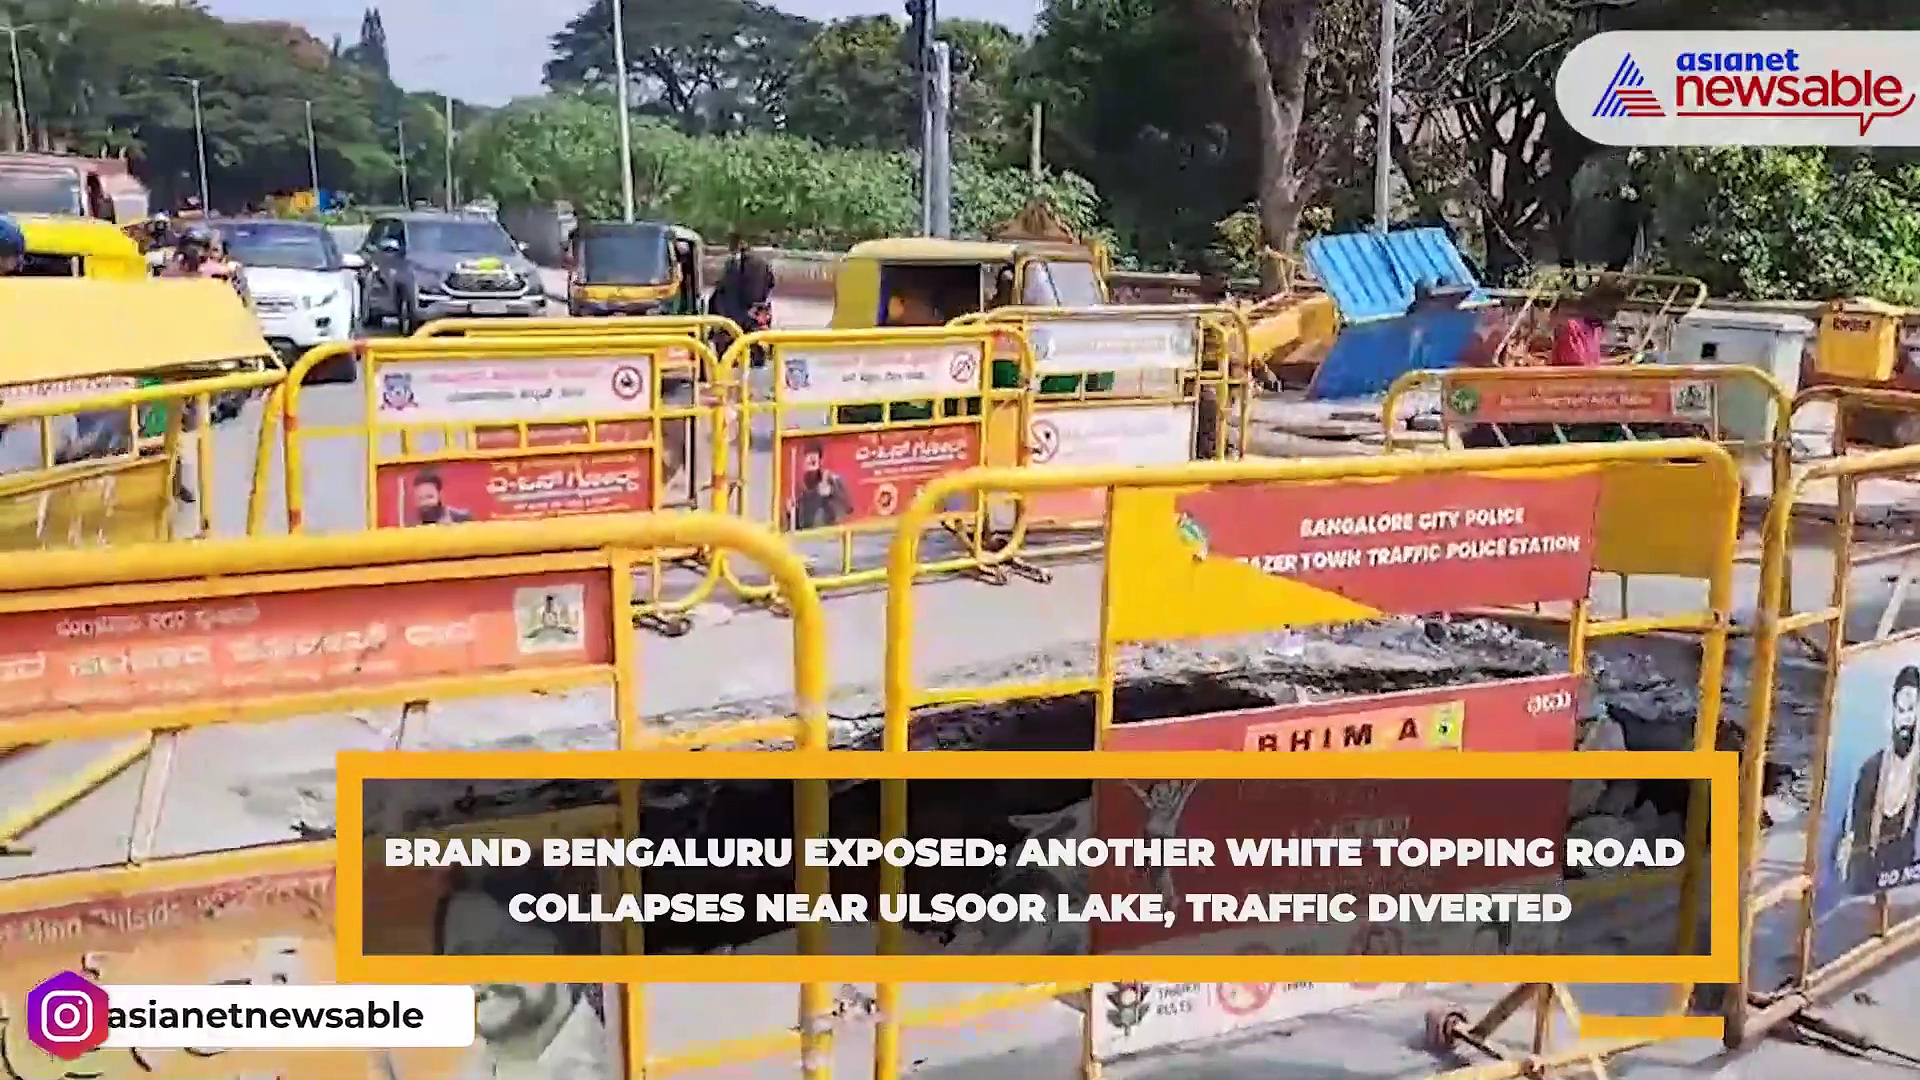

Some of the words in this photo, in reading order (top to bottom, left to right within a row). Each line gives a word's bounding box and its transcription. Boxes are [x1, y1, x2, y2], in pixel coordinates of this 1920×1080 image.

[1299, 511, 1414, 537] BANGALORE
[1418, 510, 1460, 530] CITY
[1465, 507, 1525, 527] POLICE
[1298, 548, 1361, 570] TOWN
[1367, 542, 1441, 567] TRAFFIC
[1446, 538, 1507, 560] POLICE
[1508, 534, 1581, 556] STATION
